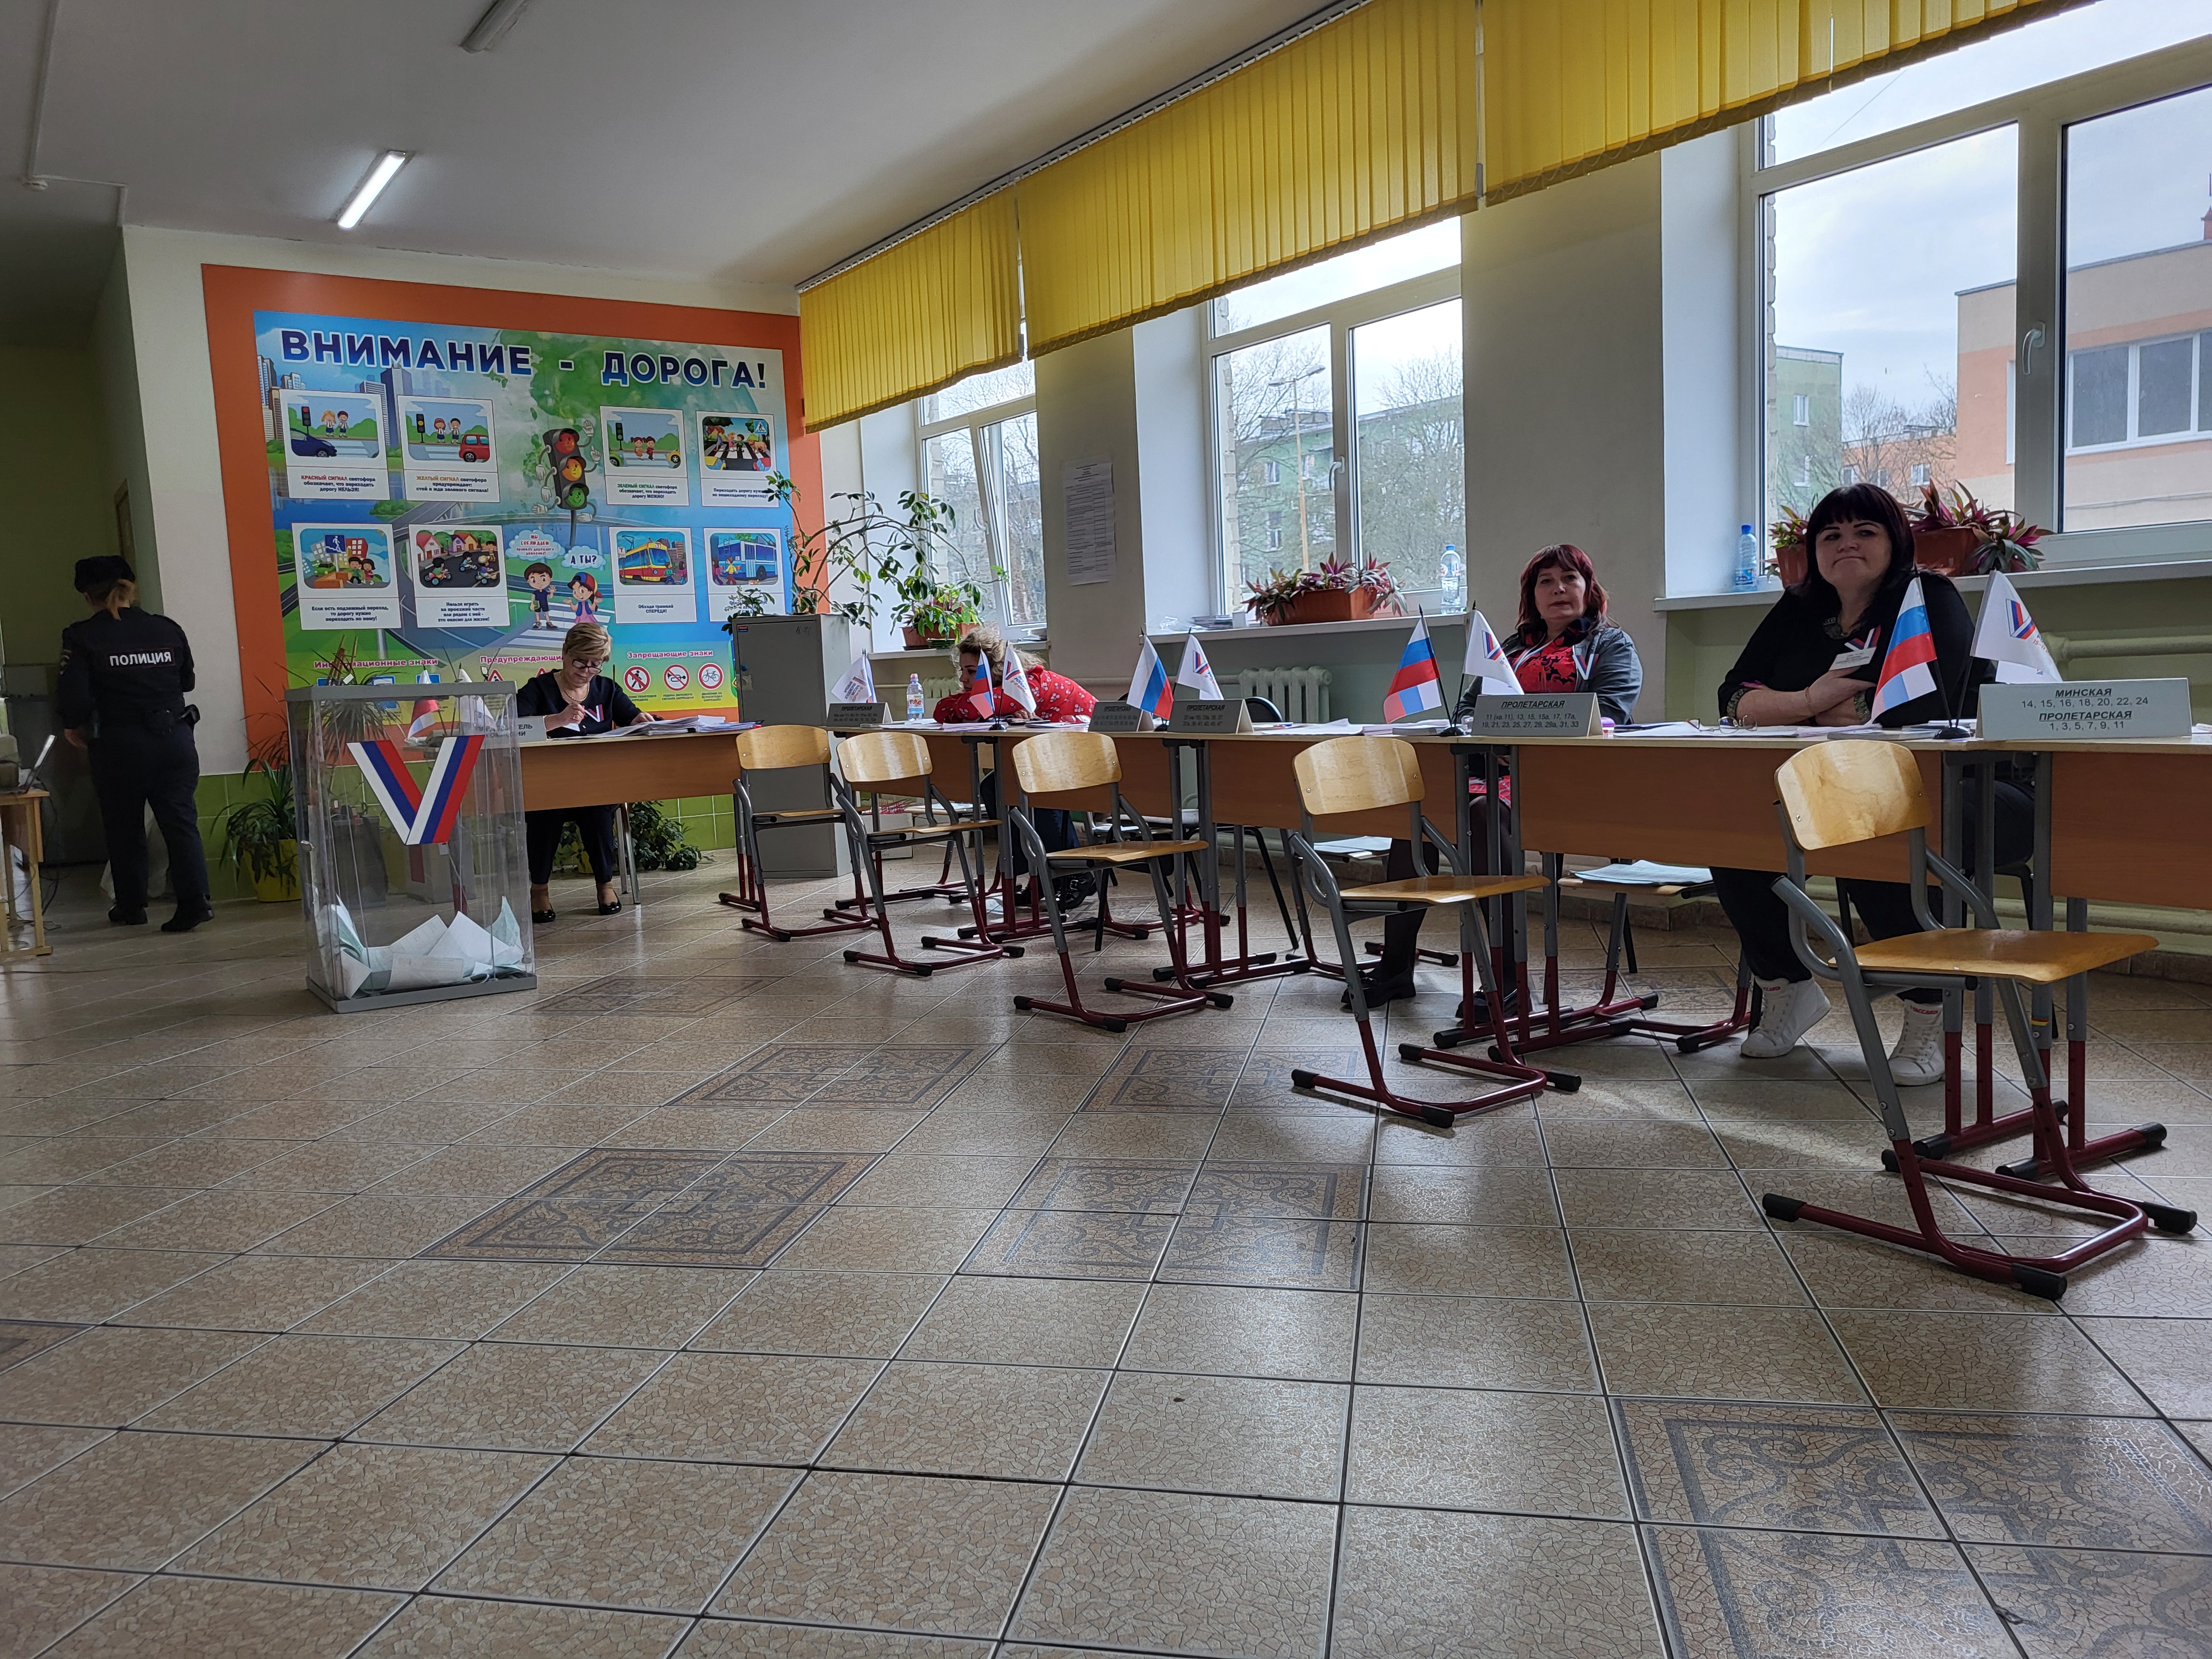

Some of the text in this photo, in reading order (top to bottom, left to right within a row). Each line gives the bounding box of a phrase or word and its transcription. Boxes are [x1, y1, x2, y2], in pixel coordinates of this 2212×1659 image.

[280, 330, 765, 388] ВНИМАНИЕ - ДОРОГА!
[571, 555, 597, 565] А ТЫ?
[109, 651, 172, 666] ПОЛИЦИЯ
[627, 651, 687, 660] Запрещающие
[314, 660, 406, 669] Инрмационные
[2055, 688, 2112, 698] МИНСКАЯ
[1501, 700, 1566, 708] ПРОЛЕТАРСКАЯ
[2022, 696, 2148, 708] 14, 15, 16, 18, 20, 22, 24
[2039, 711, 2132, 721] ПРОЛЕТАРСКАЯ
[2049, 721, 2124, 731] 1, 3, 5, 7, 9, 11
